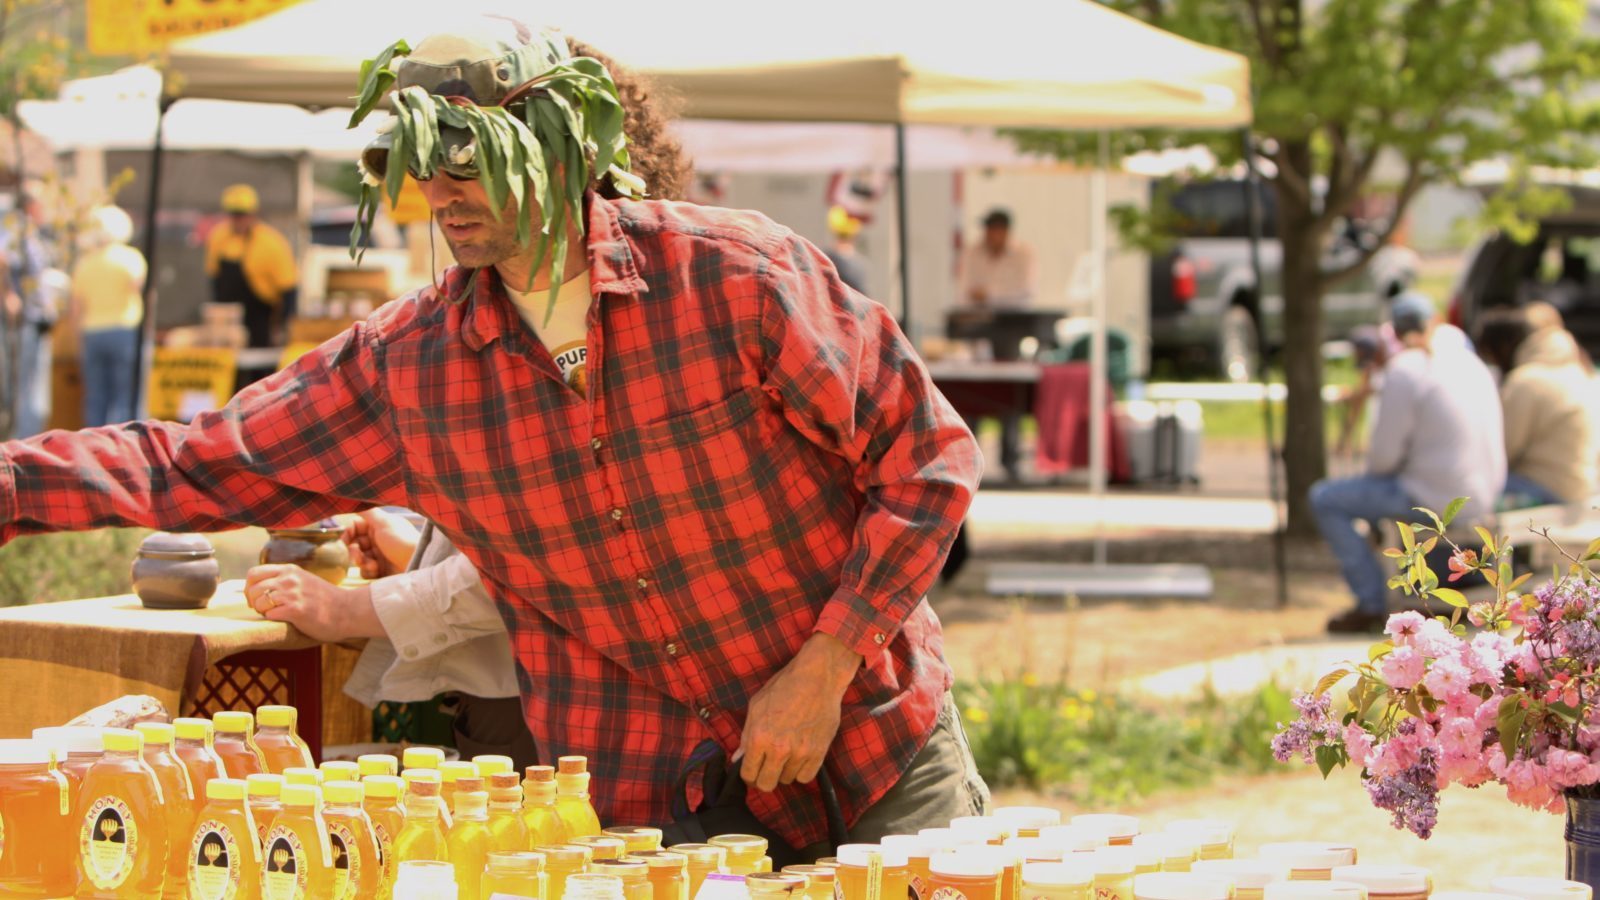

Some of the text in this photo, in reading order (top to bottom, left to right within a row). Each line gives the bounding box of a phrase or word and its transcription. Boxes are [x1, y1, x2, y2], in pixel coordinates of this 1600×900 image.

[88, 797, 133, 820] HONEY
[194, 820, 236, 845] HONEY
[265, 826, 302, 850] HONEY
[327, 823, 354, 845] NEY
